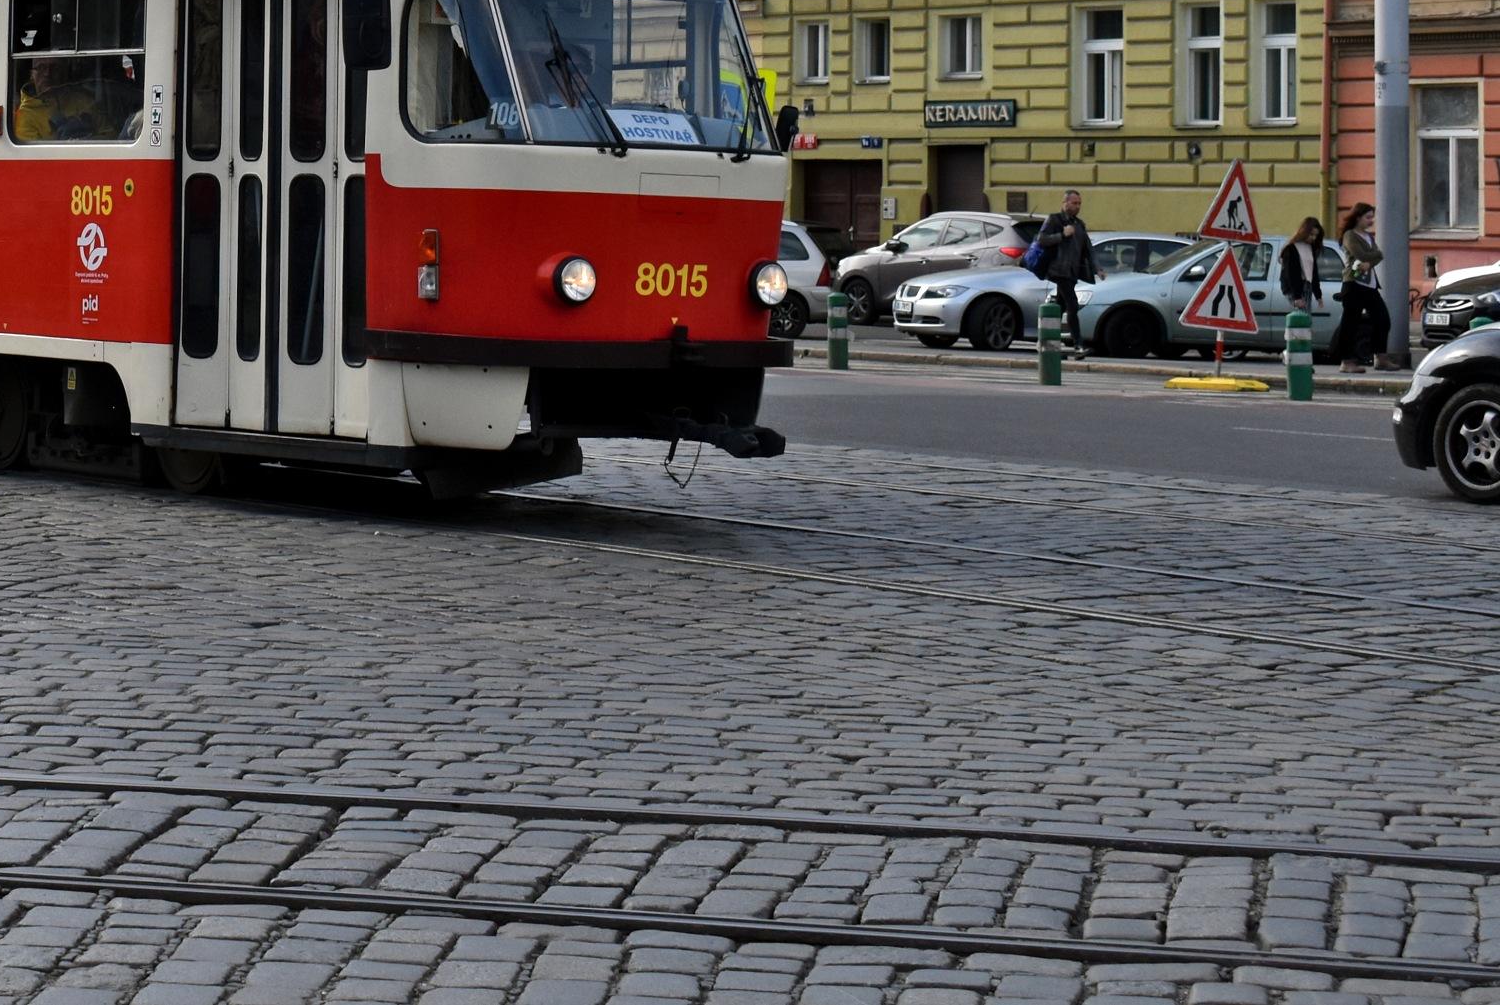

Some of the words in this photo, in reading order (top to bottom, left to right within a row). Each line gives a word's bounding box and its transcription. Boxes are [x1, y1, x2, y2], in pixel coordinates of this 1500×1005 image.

[490, 102, 519, 126] 106
[631, 113, 669, 126] DEPO
[925, 104, 1009, 122] KERAMIKA
[622, 126, 694, 143] HOSTIVAŘ
[71, 185, 113, 216] 8015
[635, 262, 708, 298] 8015
[82, 294, 99, 315] pid
